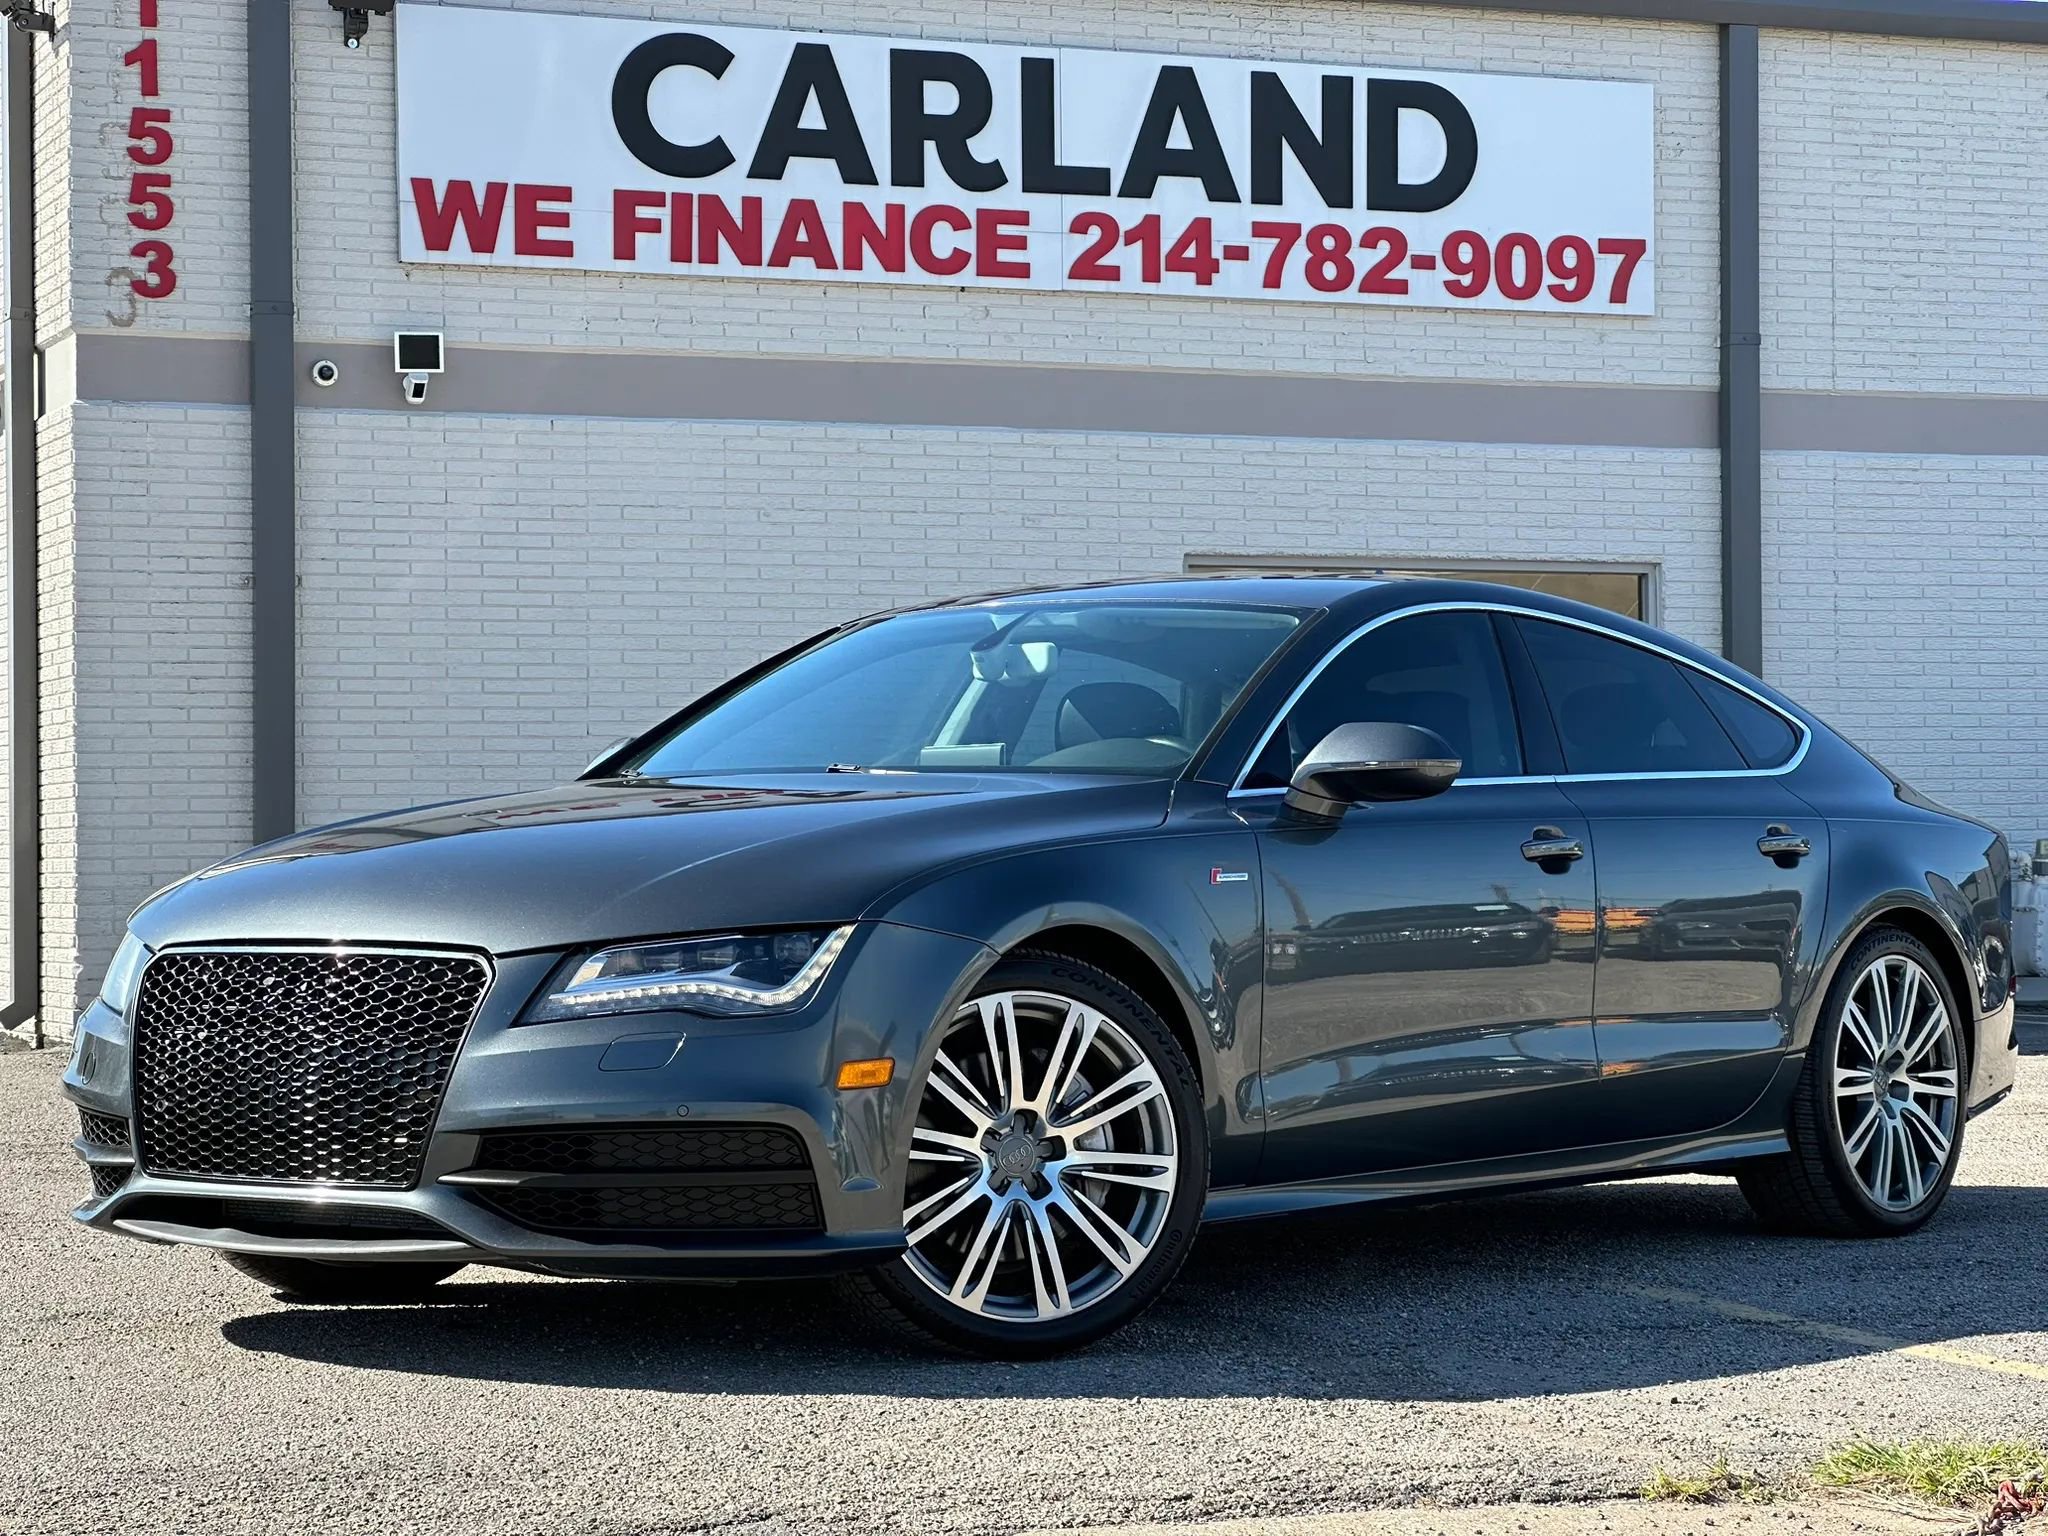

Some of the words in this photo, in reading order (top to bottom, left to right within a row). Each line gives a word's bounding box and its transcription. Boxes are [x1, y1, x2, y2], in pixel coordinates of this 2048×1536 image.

[611, 32, 1479, 213] CARLAND
[410, 177, 574, 258] WE
[613, 188, 1031, 279] FINANCE
[1067, 211, 1647, 304] 214-782-9097
[1851, 933, 1923, 970] CONTINENTAL
[1051, 967, 1190, 1090] CONTINENTAL
